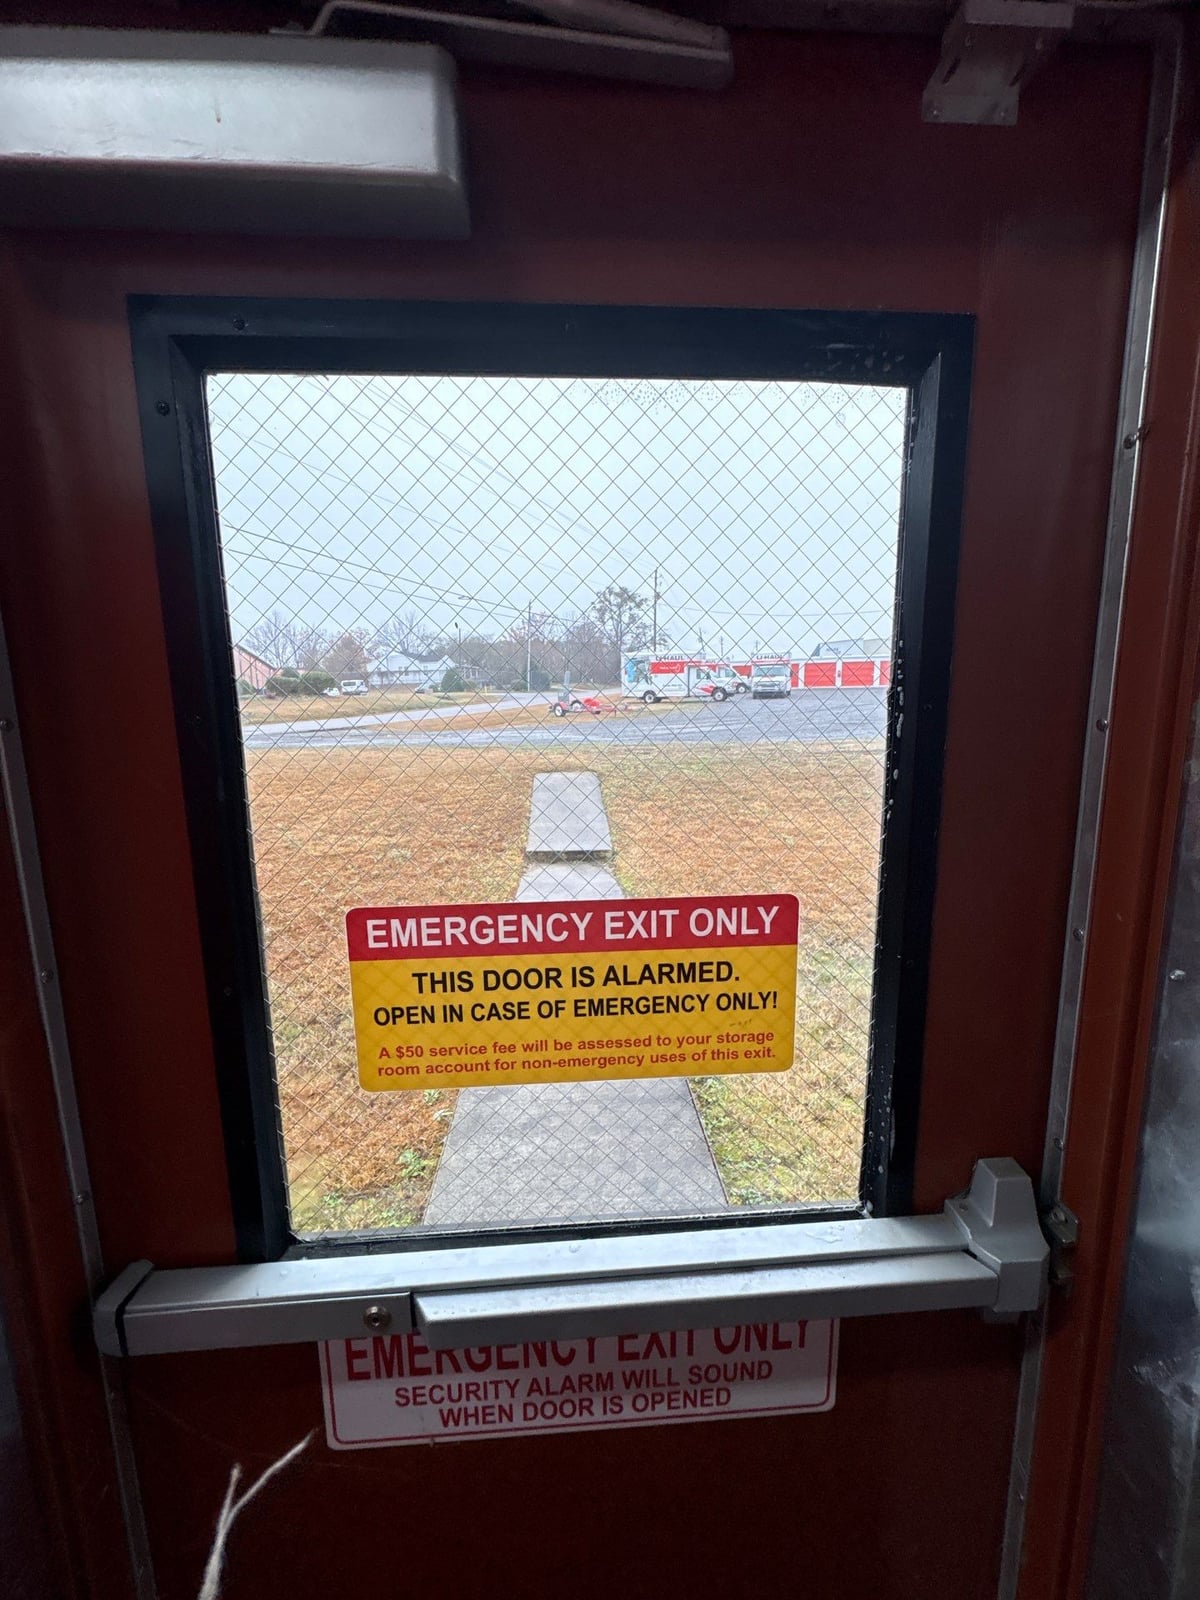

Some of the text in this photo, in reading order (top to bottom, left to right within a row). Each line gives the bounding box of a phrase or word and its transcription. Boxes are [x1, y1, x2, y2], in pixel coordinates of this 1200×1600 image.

[366, 905, 780, 949] EMERGENCY EXIT ONLY
[412, 960, 740, 994] THIS DOOR IS ALARMED.
[374, 991, 778, 1026] OPEN IN CASE OF EMERGENCY ONLY!
[378, 1030, 775, 1060] A $50 service fee will be assessed to your storage
[378, 1046, 776, 1077] room account for non-emergency uses of this exit.
[394, 1360, 774, 1407] SECURITY ALARM WILL SOUND
[439, 1388, 732, 1428] WHEN DOOR IS OPENED
